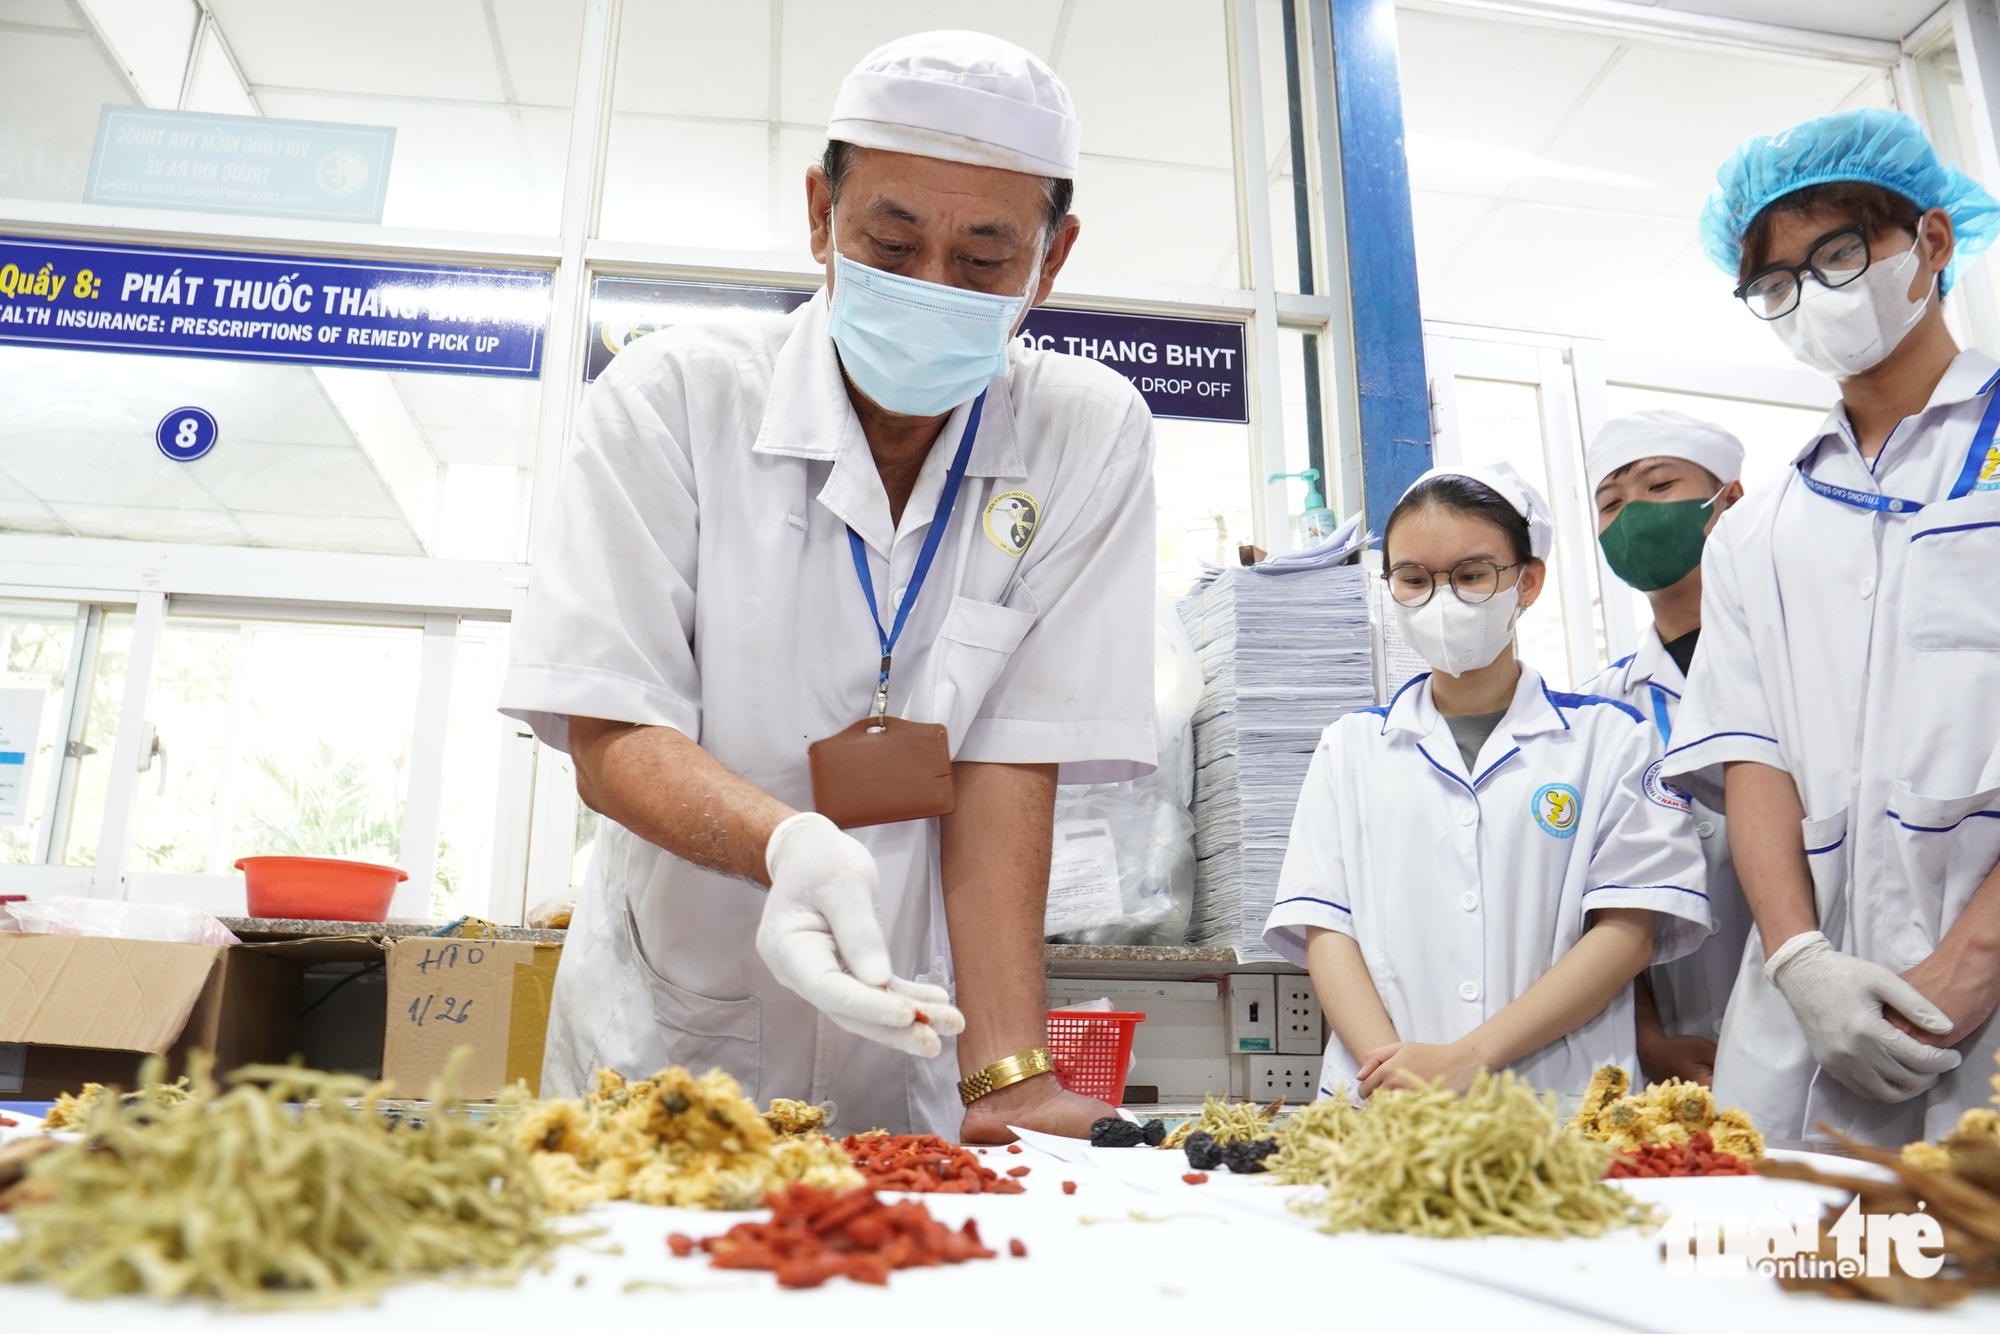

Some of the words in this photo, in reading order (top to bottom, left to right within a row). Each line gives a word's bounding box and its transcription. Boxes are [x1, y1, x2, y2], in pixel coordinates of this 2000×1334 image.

[0, 262, 66, 301] Quầy
[73, 268, 101, 299] 8:
[121, 268, 203, 305] PHÁT
[214, 272, 313, 312] THUỐC
[0, 305, 51, 325] ALTH
[56, 308, 165, 332] INSURANCE:
[171, 316, 313, 342] PRESCRIPTIONS
[317, 325, 342, 343] OF
[346, 327, 423, 348] REMEDY
[428, 332, 469, 351] PICK
[475, 336, 500, 353] UP
[1063, 336, 1158, 364] THANG
[1166, 344, 1236, 370] BHYT
[1141, 376, 1192, 395] DROP
[1197, 381, 1231, 398] OFF
[174, 417, 199, 448] 8
[408, 994, 473, 1027] 1/26
